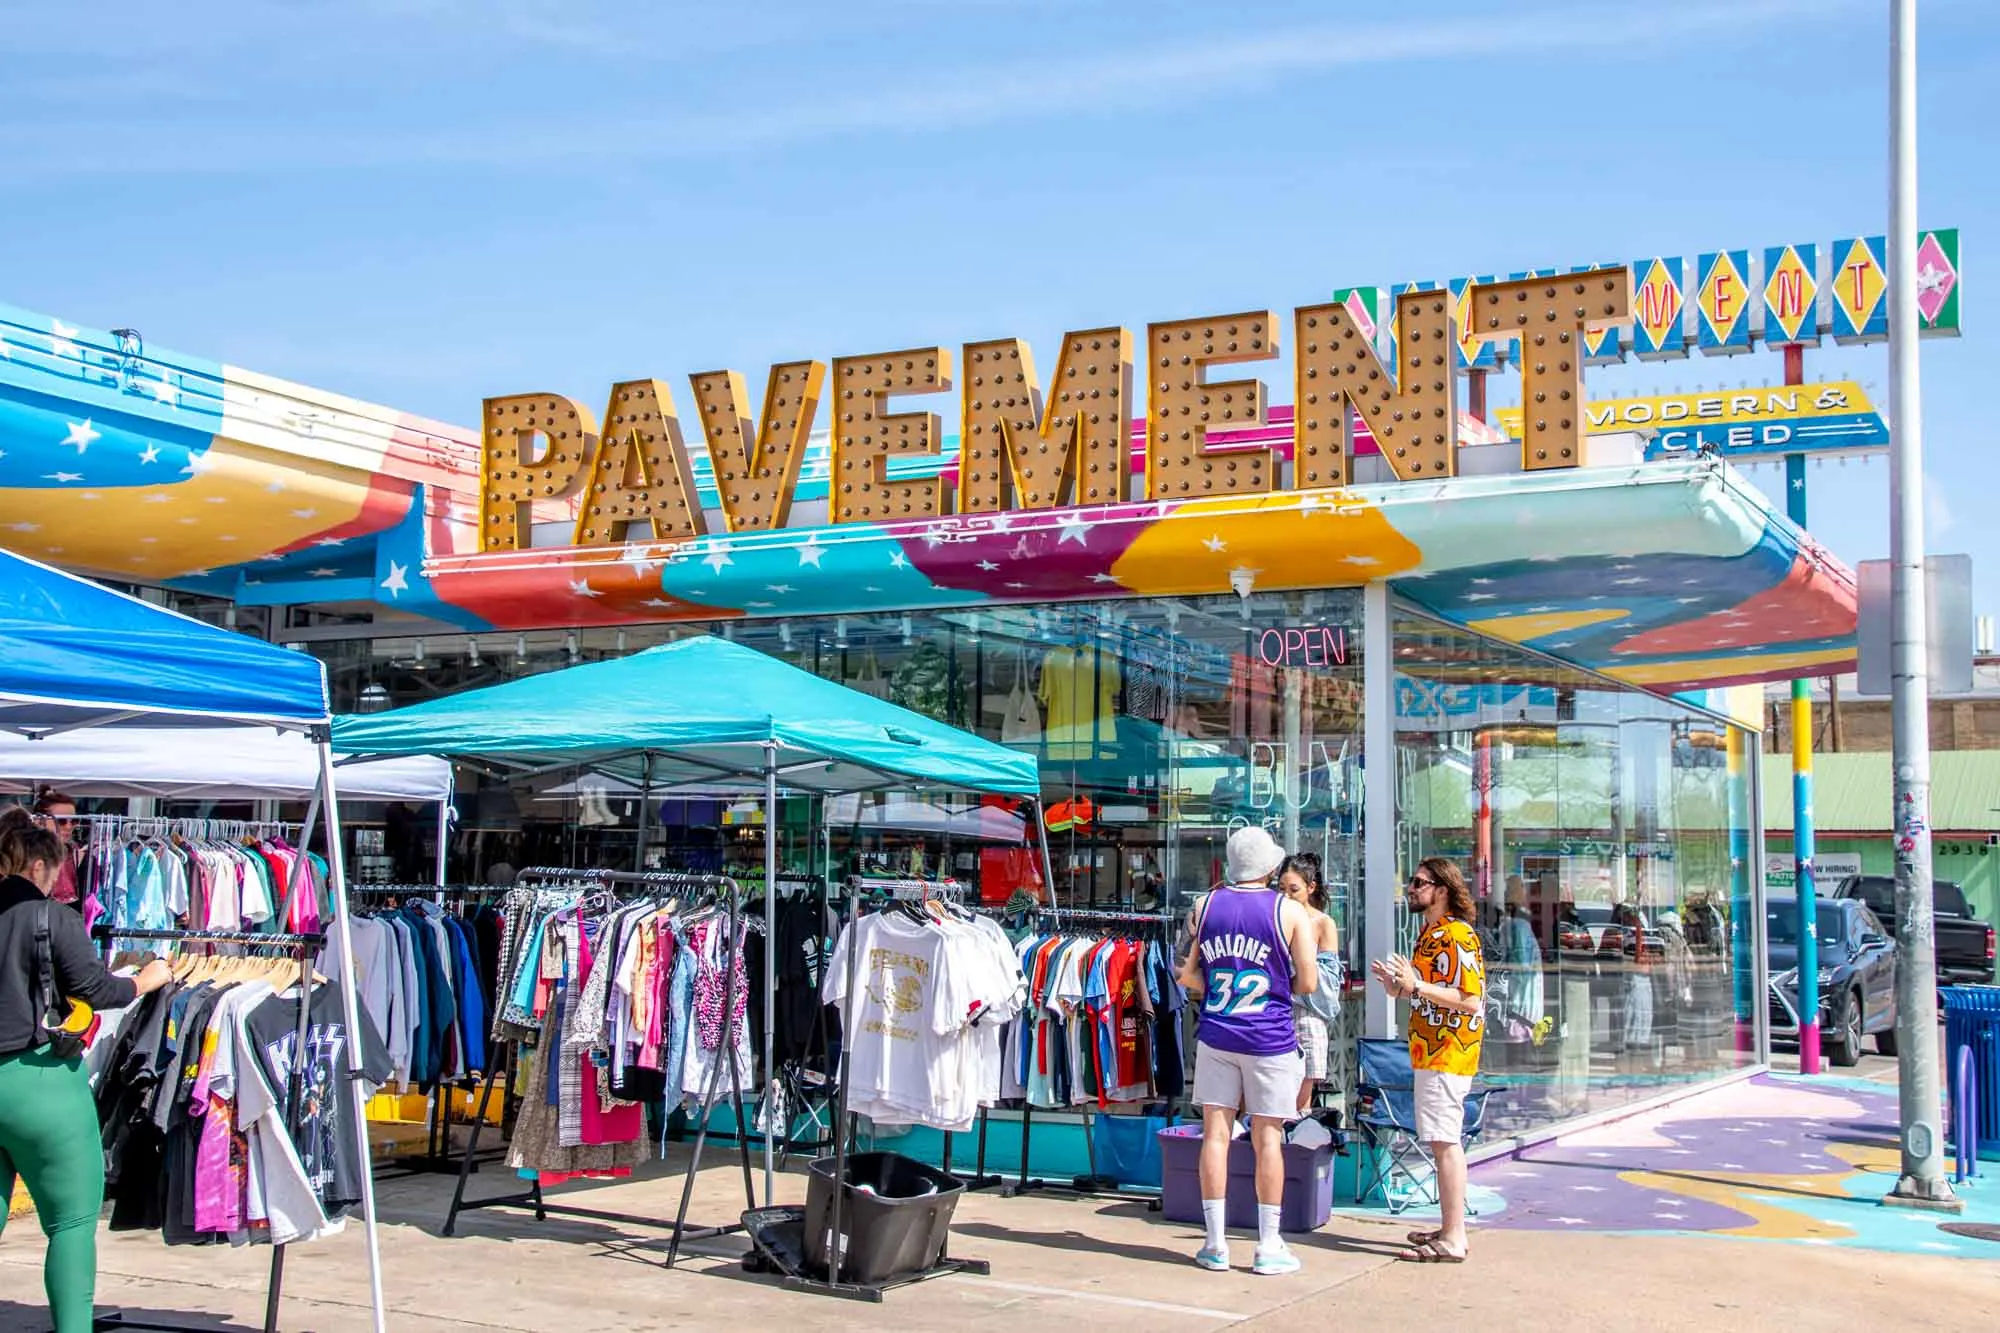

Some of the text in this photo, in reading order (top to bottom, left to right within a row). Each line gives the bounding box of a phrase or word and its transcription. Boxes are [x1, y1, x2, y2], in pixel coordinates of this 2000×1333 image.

[480, 265, 1635, 553] PAVEMENT
[1584, 388, 1849, 426] MODERN &
[1260, 627, 1345, 667] OPEN
[1250, 739, 1348, 810] BUY
[1939, 845, 1988, 856] 2938
[1200, 934, 1272, 966] MALONE
[1205, 967, 1272, 1016] 32
